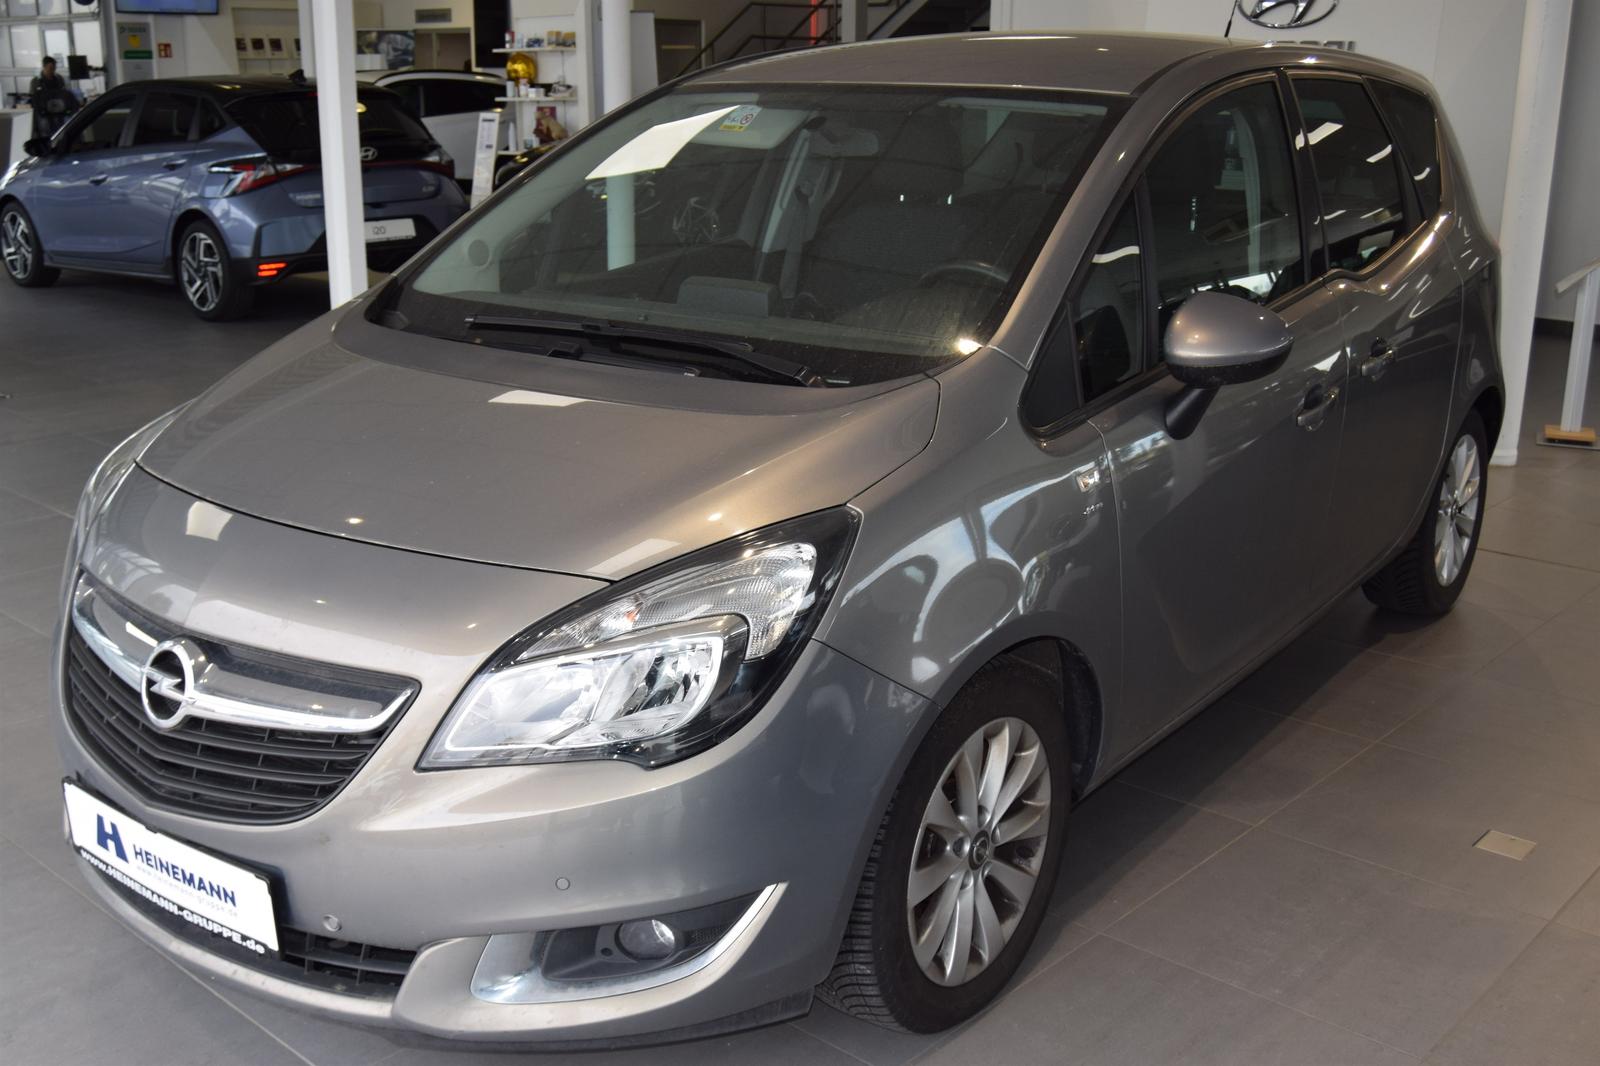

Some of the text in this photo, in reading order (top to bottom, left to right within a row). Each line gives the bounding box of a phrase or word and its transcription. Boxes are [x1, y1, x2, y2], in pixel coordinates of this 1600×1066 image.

[97, 814, 129, 863] H
[81, 850, 266, 954] www.HEINEMANN-GRUPPE.de
[133, 844, 237, 907] HEINEMANN
